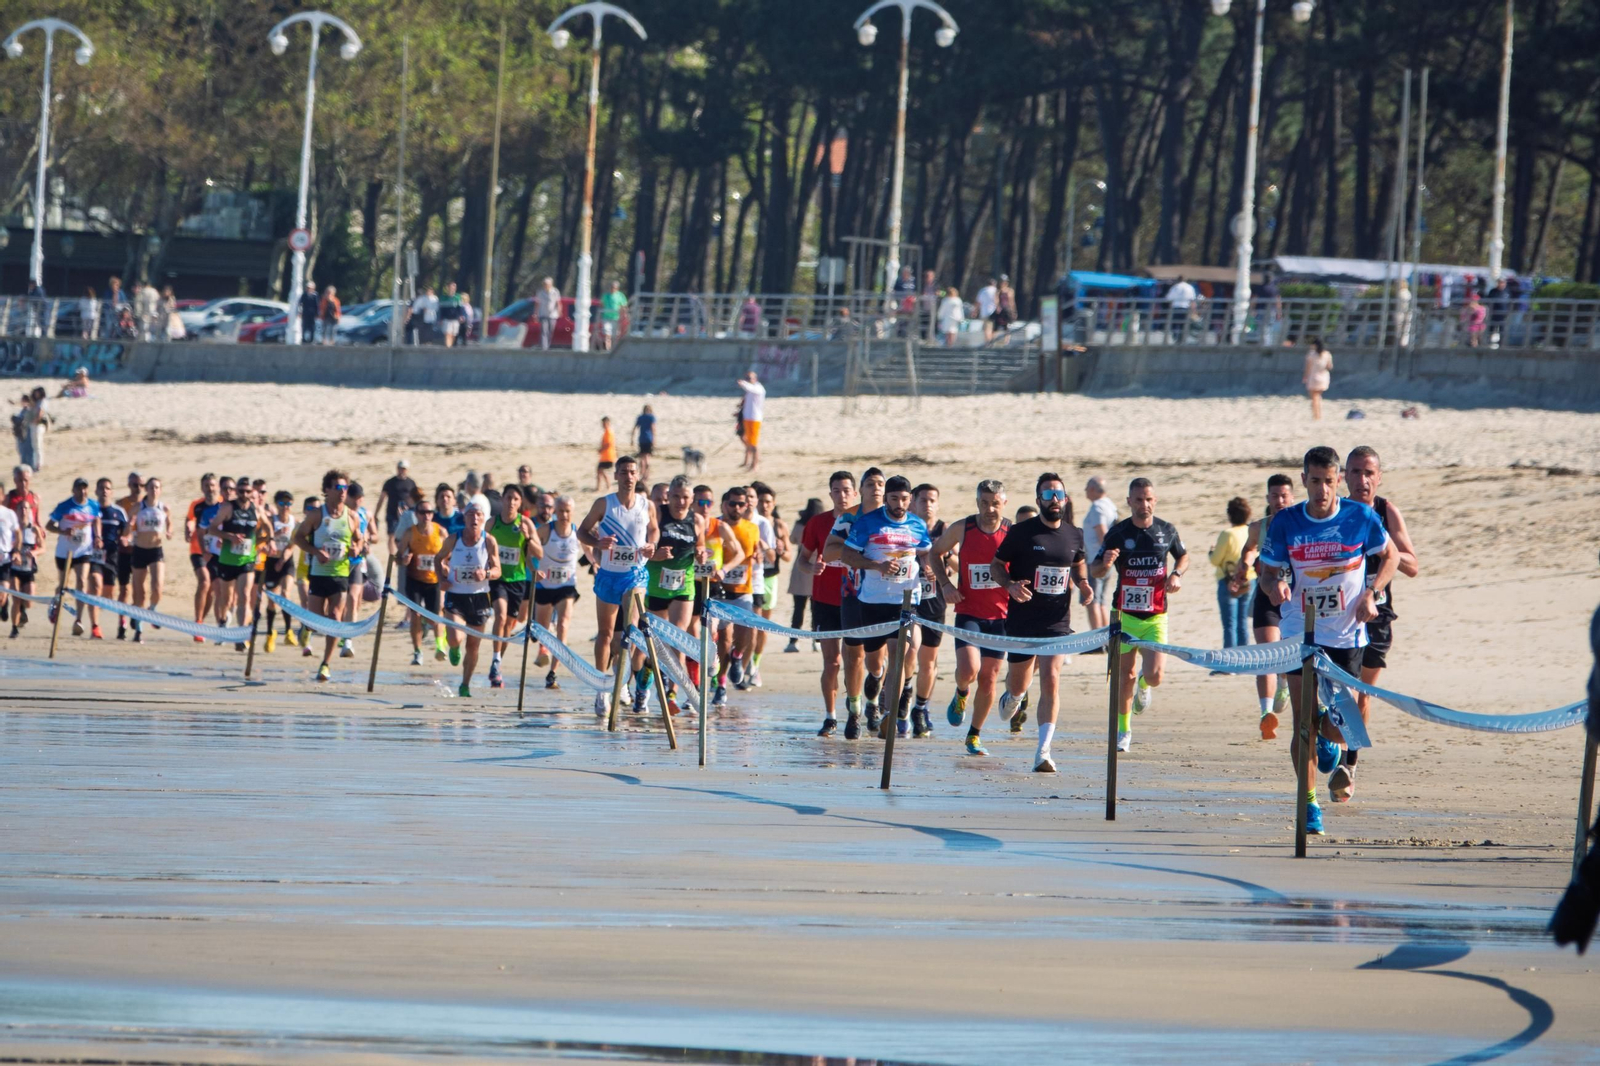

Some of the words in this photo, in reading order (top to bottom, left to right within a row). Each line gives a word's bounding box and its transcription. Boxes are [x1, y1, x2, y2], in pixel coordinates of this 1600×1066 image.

[1305, 544, 1342, 554] CARREIRA
[614, 552, 634, 560] 266
[1128, 557, 1158, 566] GMTA
[694, 566, 712, 574] 259
[894, 566, 908, 576] 29
[1280, 568, 1292, 578] 09
[974, 572, 992, 582] 19
[1041, 574, 1064, 586] 384
[1127, 593, 1148, 603] 281
[1307, 594, 1338, 610] 175
